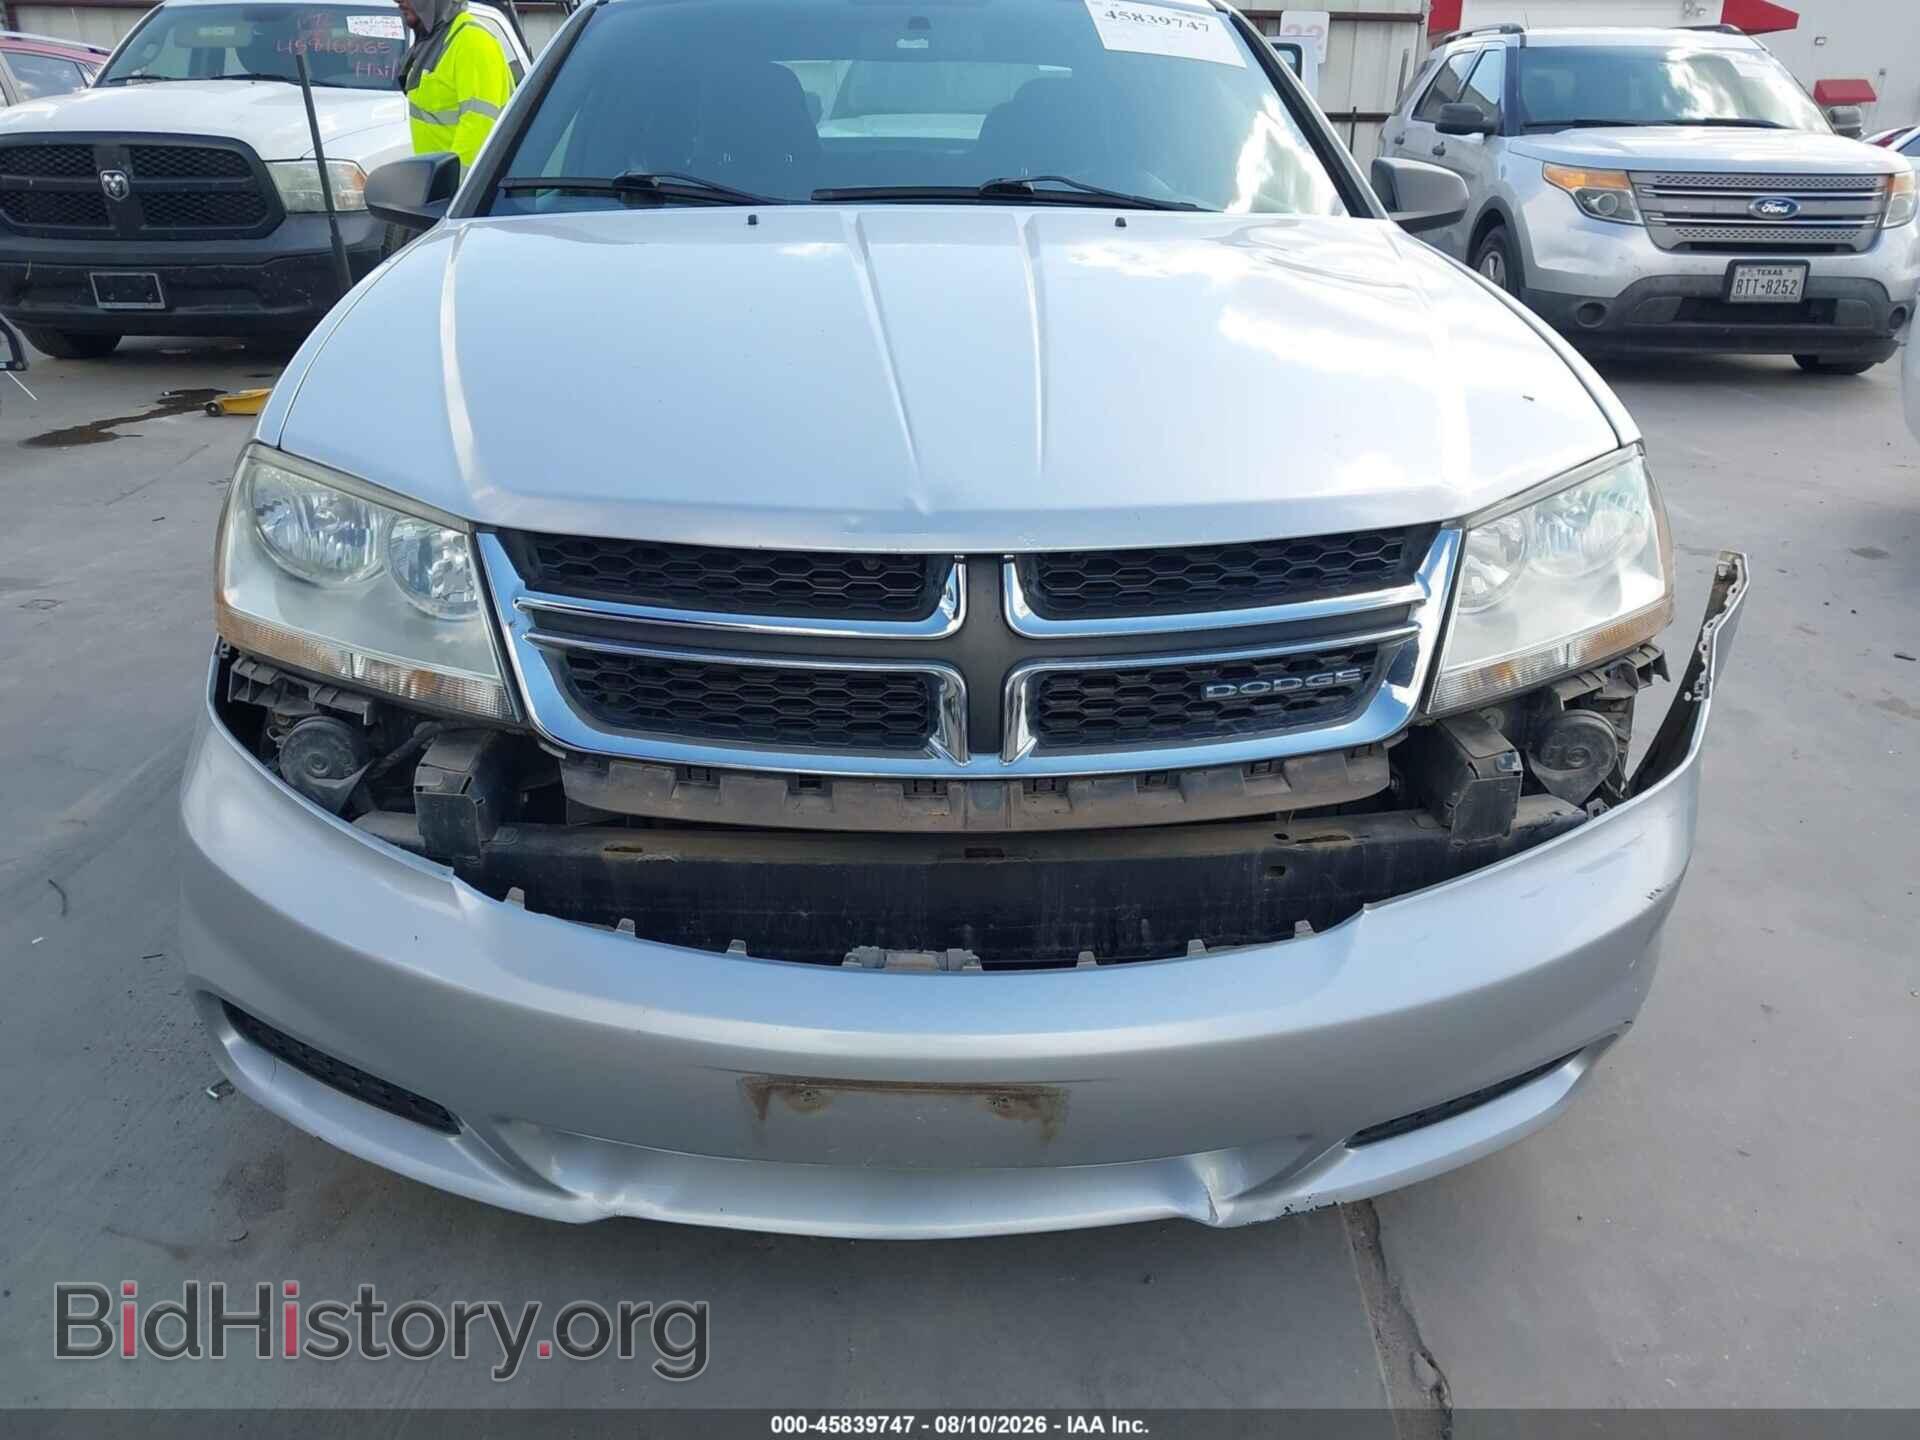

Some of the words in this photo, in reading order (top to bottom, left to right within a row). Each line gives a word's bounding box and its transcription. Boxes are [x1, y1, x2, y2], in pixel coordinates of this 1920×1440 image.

[1104, 9, 1210, 33] 45839747
[1761, 200, 1791, 214] Ford
[1757, 268, 1784, 276] TEXAS
[1206, 668, 1361, 698] DODGE
